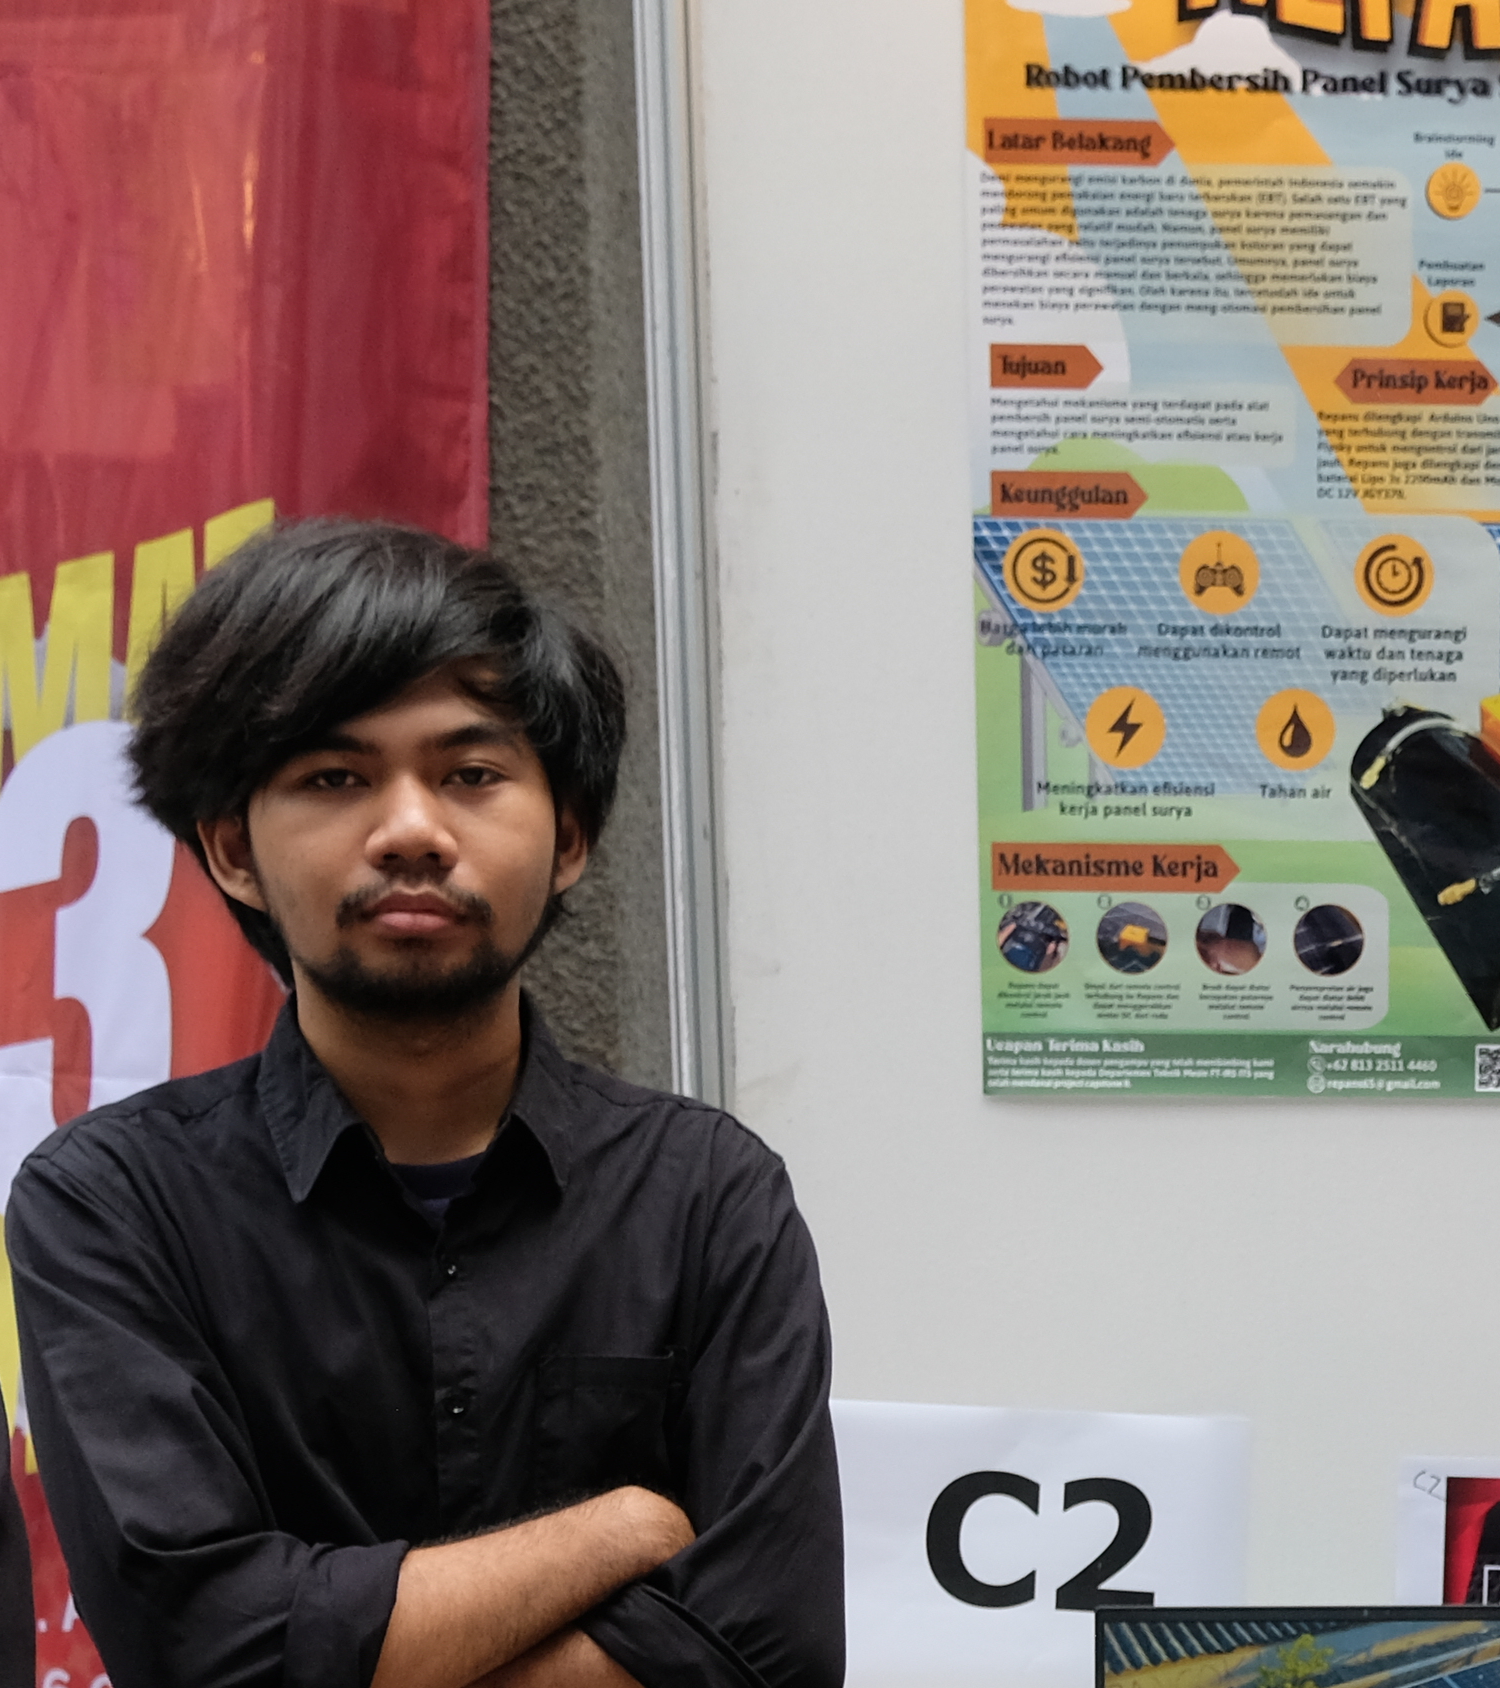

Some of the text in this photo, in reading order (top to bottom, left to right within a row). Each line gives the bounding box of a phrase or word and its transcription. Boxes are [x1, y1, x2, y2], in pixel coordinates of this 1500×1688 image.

[1025, 63, 1108, 91] Robot
[1122, 66, 1291, 94] Pembersih
[1300, 68, 1387, 96] Panel
[1397, 71, 1490, 104] Surya
[987, 129, 1153, 158] Latar Belakang
[1000, 354, 1067, 380] Tujuan
[1352, 368, 1490, 395] Prinsip Kerja
[1000, 482, 1130, 512] Keunggulan
[1157, 622, 1282, 640] Dapat dikontrol
[1320, 624, 1467, 646] Dapat mengurangi
[1323, 646, 1465, 666] waktu dan tenaga
[1331, 666, 1457, 686] yang diperlukan
[1036, 780, 1216, 801] Meningkatkan efisiensi
[1259, 783, 1332, 800] Tahan air
[1059, 801, 1193, 820] kerja panel surya
[998, 852, 1219, 883] Mekanisme Kerja
[924, 1470, 1156, 1611] C2
